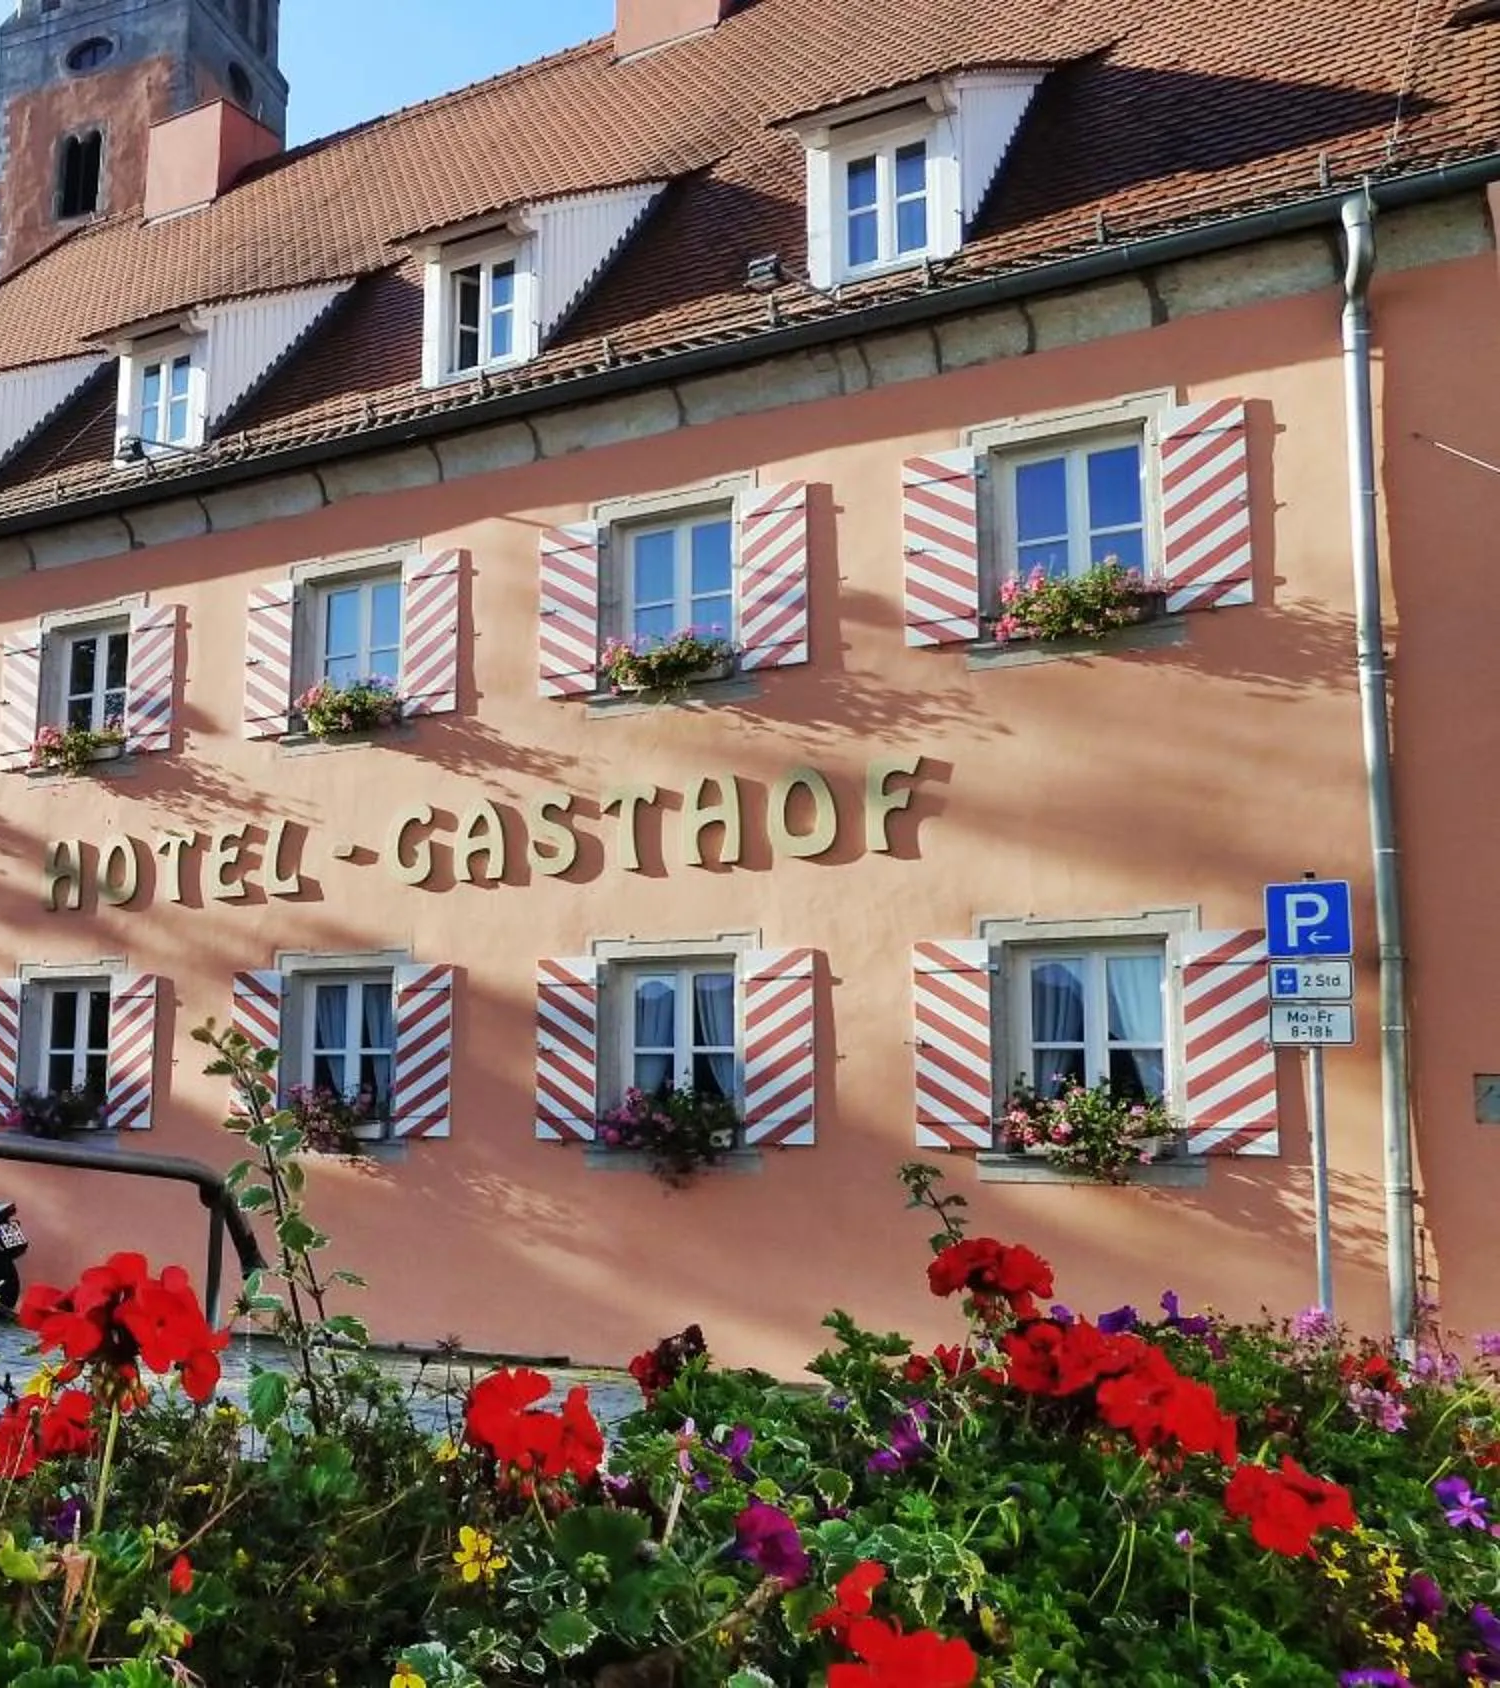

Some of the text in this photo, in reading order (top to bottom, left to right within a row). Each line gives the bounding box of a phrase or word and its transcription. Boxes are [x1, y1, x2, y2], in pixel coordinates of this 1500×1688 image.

[44, 818, 301, 911] HOTEL
[385, 755, 921, 887] GASTHOF
[1285, 892, 1329, 948] P
[1303, 975, 1311, 987] 2
